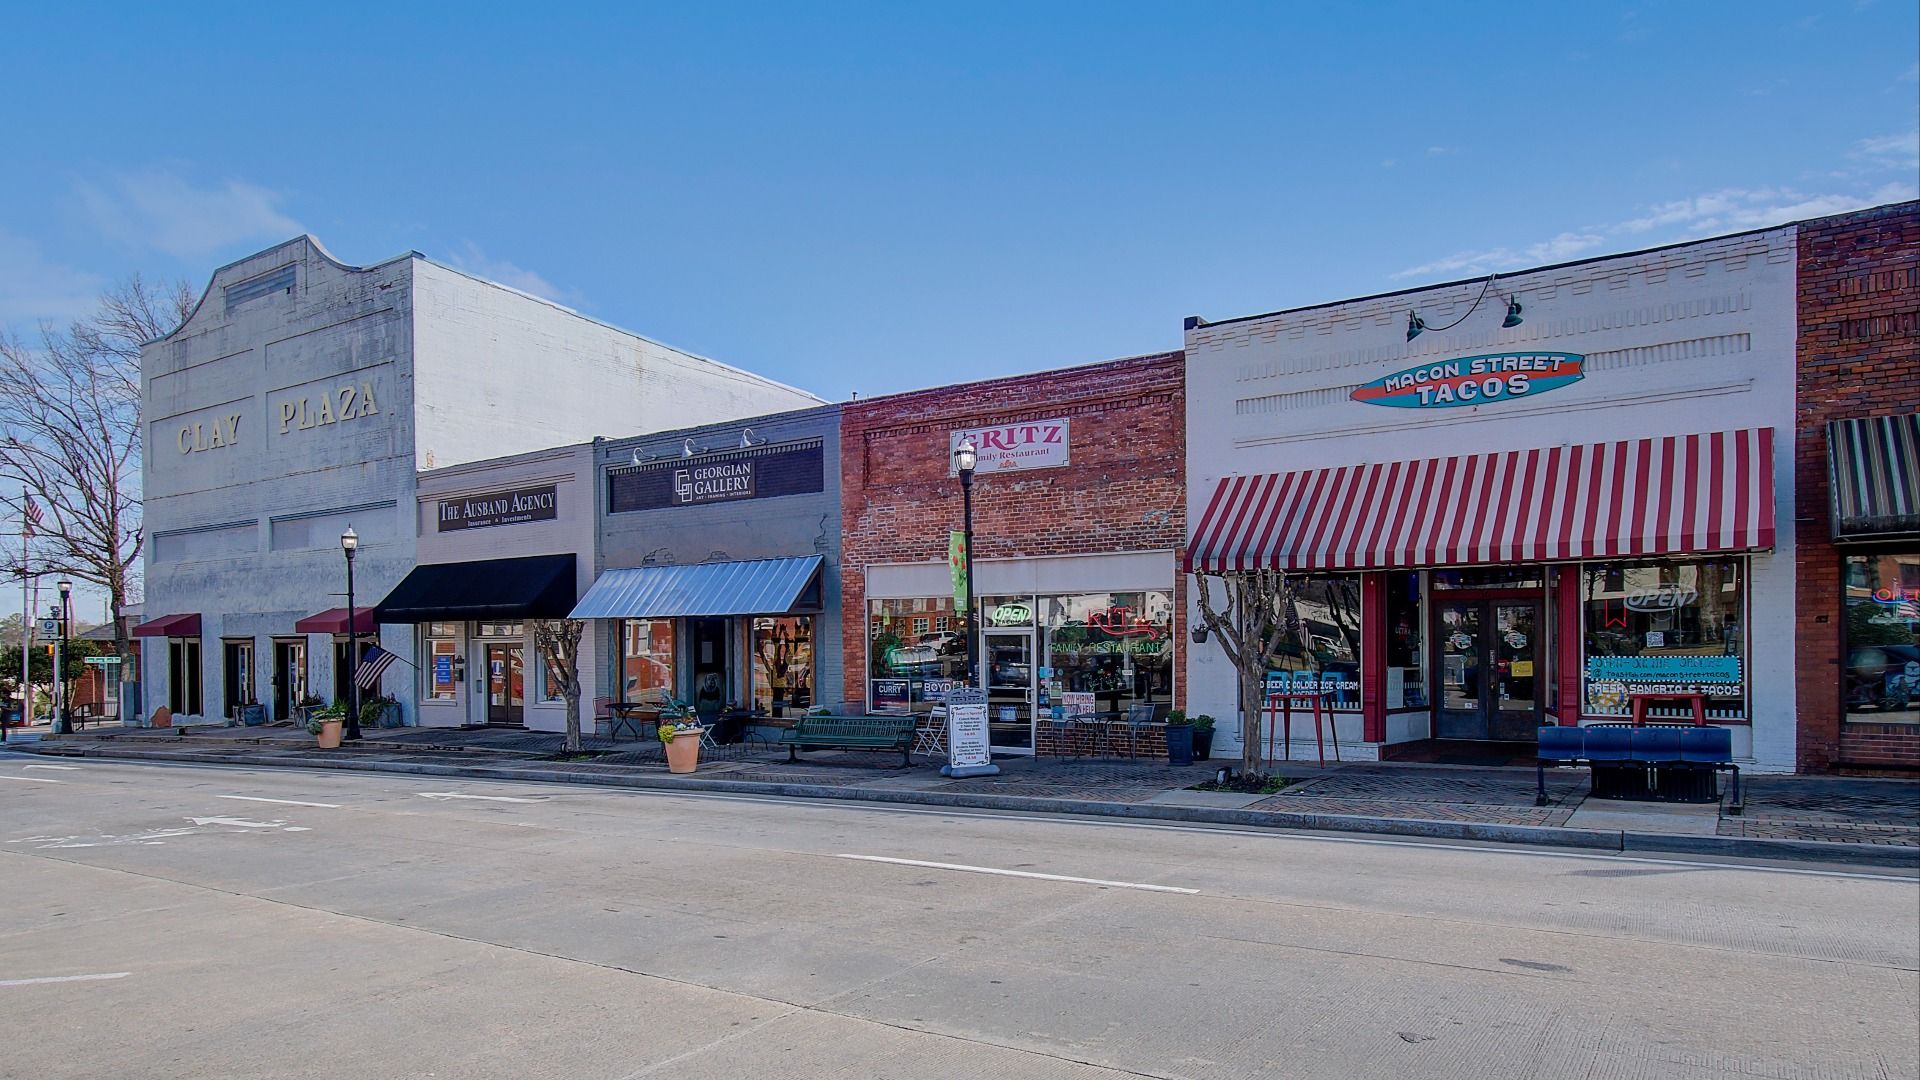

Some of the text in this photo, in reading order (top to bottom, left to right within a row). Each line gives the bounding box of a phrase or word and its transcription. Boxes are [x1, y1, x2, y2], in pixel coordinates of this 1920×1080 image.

[1384, 356, 1566, 393] MACON STREET
[1416, 373, 1531, 406] TACOS
[177, 382, 379, 455] CLAY PLAZA
[1000, 447, 1049, 460] Restaurant
[694, 462, 751, 480] GEORGIAN
[694, 475, 751, 495] GALLERY
[467, 518, 492, 527] Insurance
[501, 514, 532, 523] Investments
[1628, 587, 1688, 607] OPEN
[994, 606, 1028, 622] OPEN
[1050, 641, 1162, 653] FAMILY RESTAURANT
[878, 685, 902, 694] CURRY
[924, 682, 951, 692] BOYD
[1266, 680, 1284, 689] BEER
[1292, 680, 1318, 690] COLDER
[1320, 681, 1334, 690] ICE
[1336, 681, 1359, 690] CREAM
[1588, 683, 1624, 693] FRESH
[1701, 685, 1741, 696] TACOS
[1063, 693, 1094, 704] NOW HIRING
